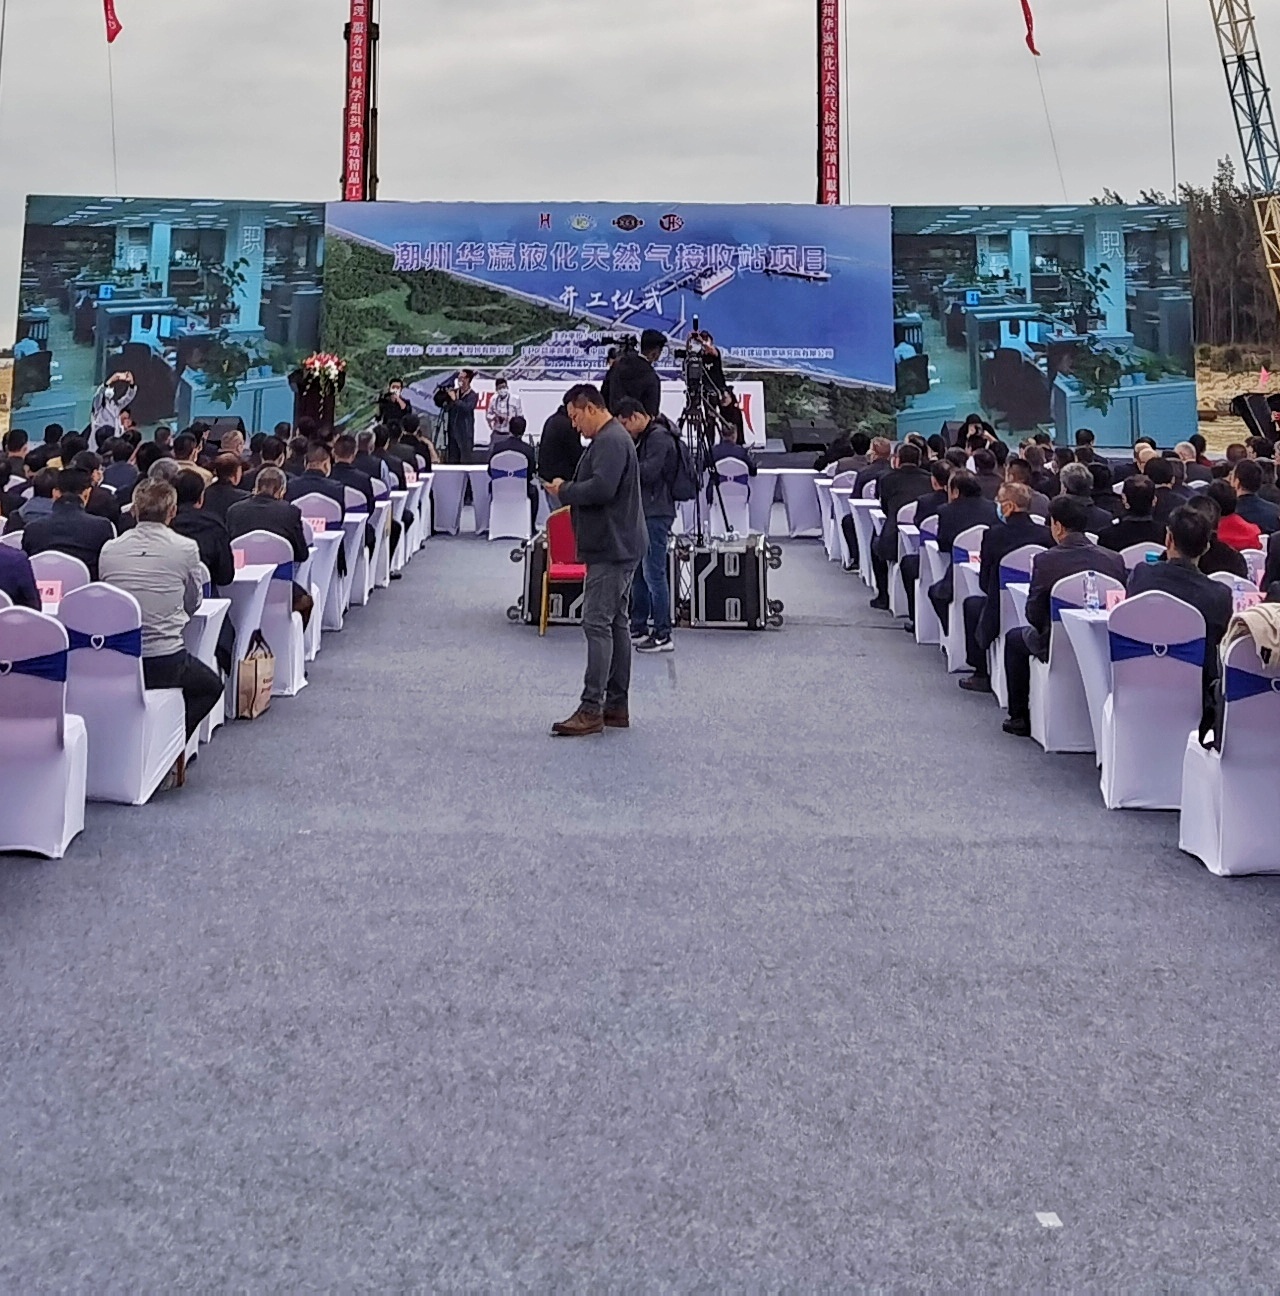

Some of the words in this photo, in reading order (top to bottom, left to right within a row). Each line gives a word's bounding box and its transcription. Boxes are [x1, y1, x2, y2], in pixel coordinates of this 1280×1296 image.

[392, 241, 827, 273] 潮州华瀛液化天然气接收站项目
[558, 285, 663, 316] 开工仪式
